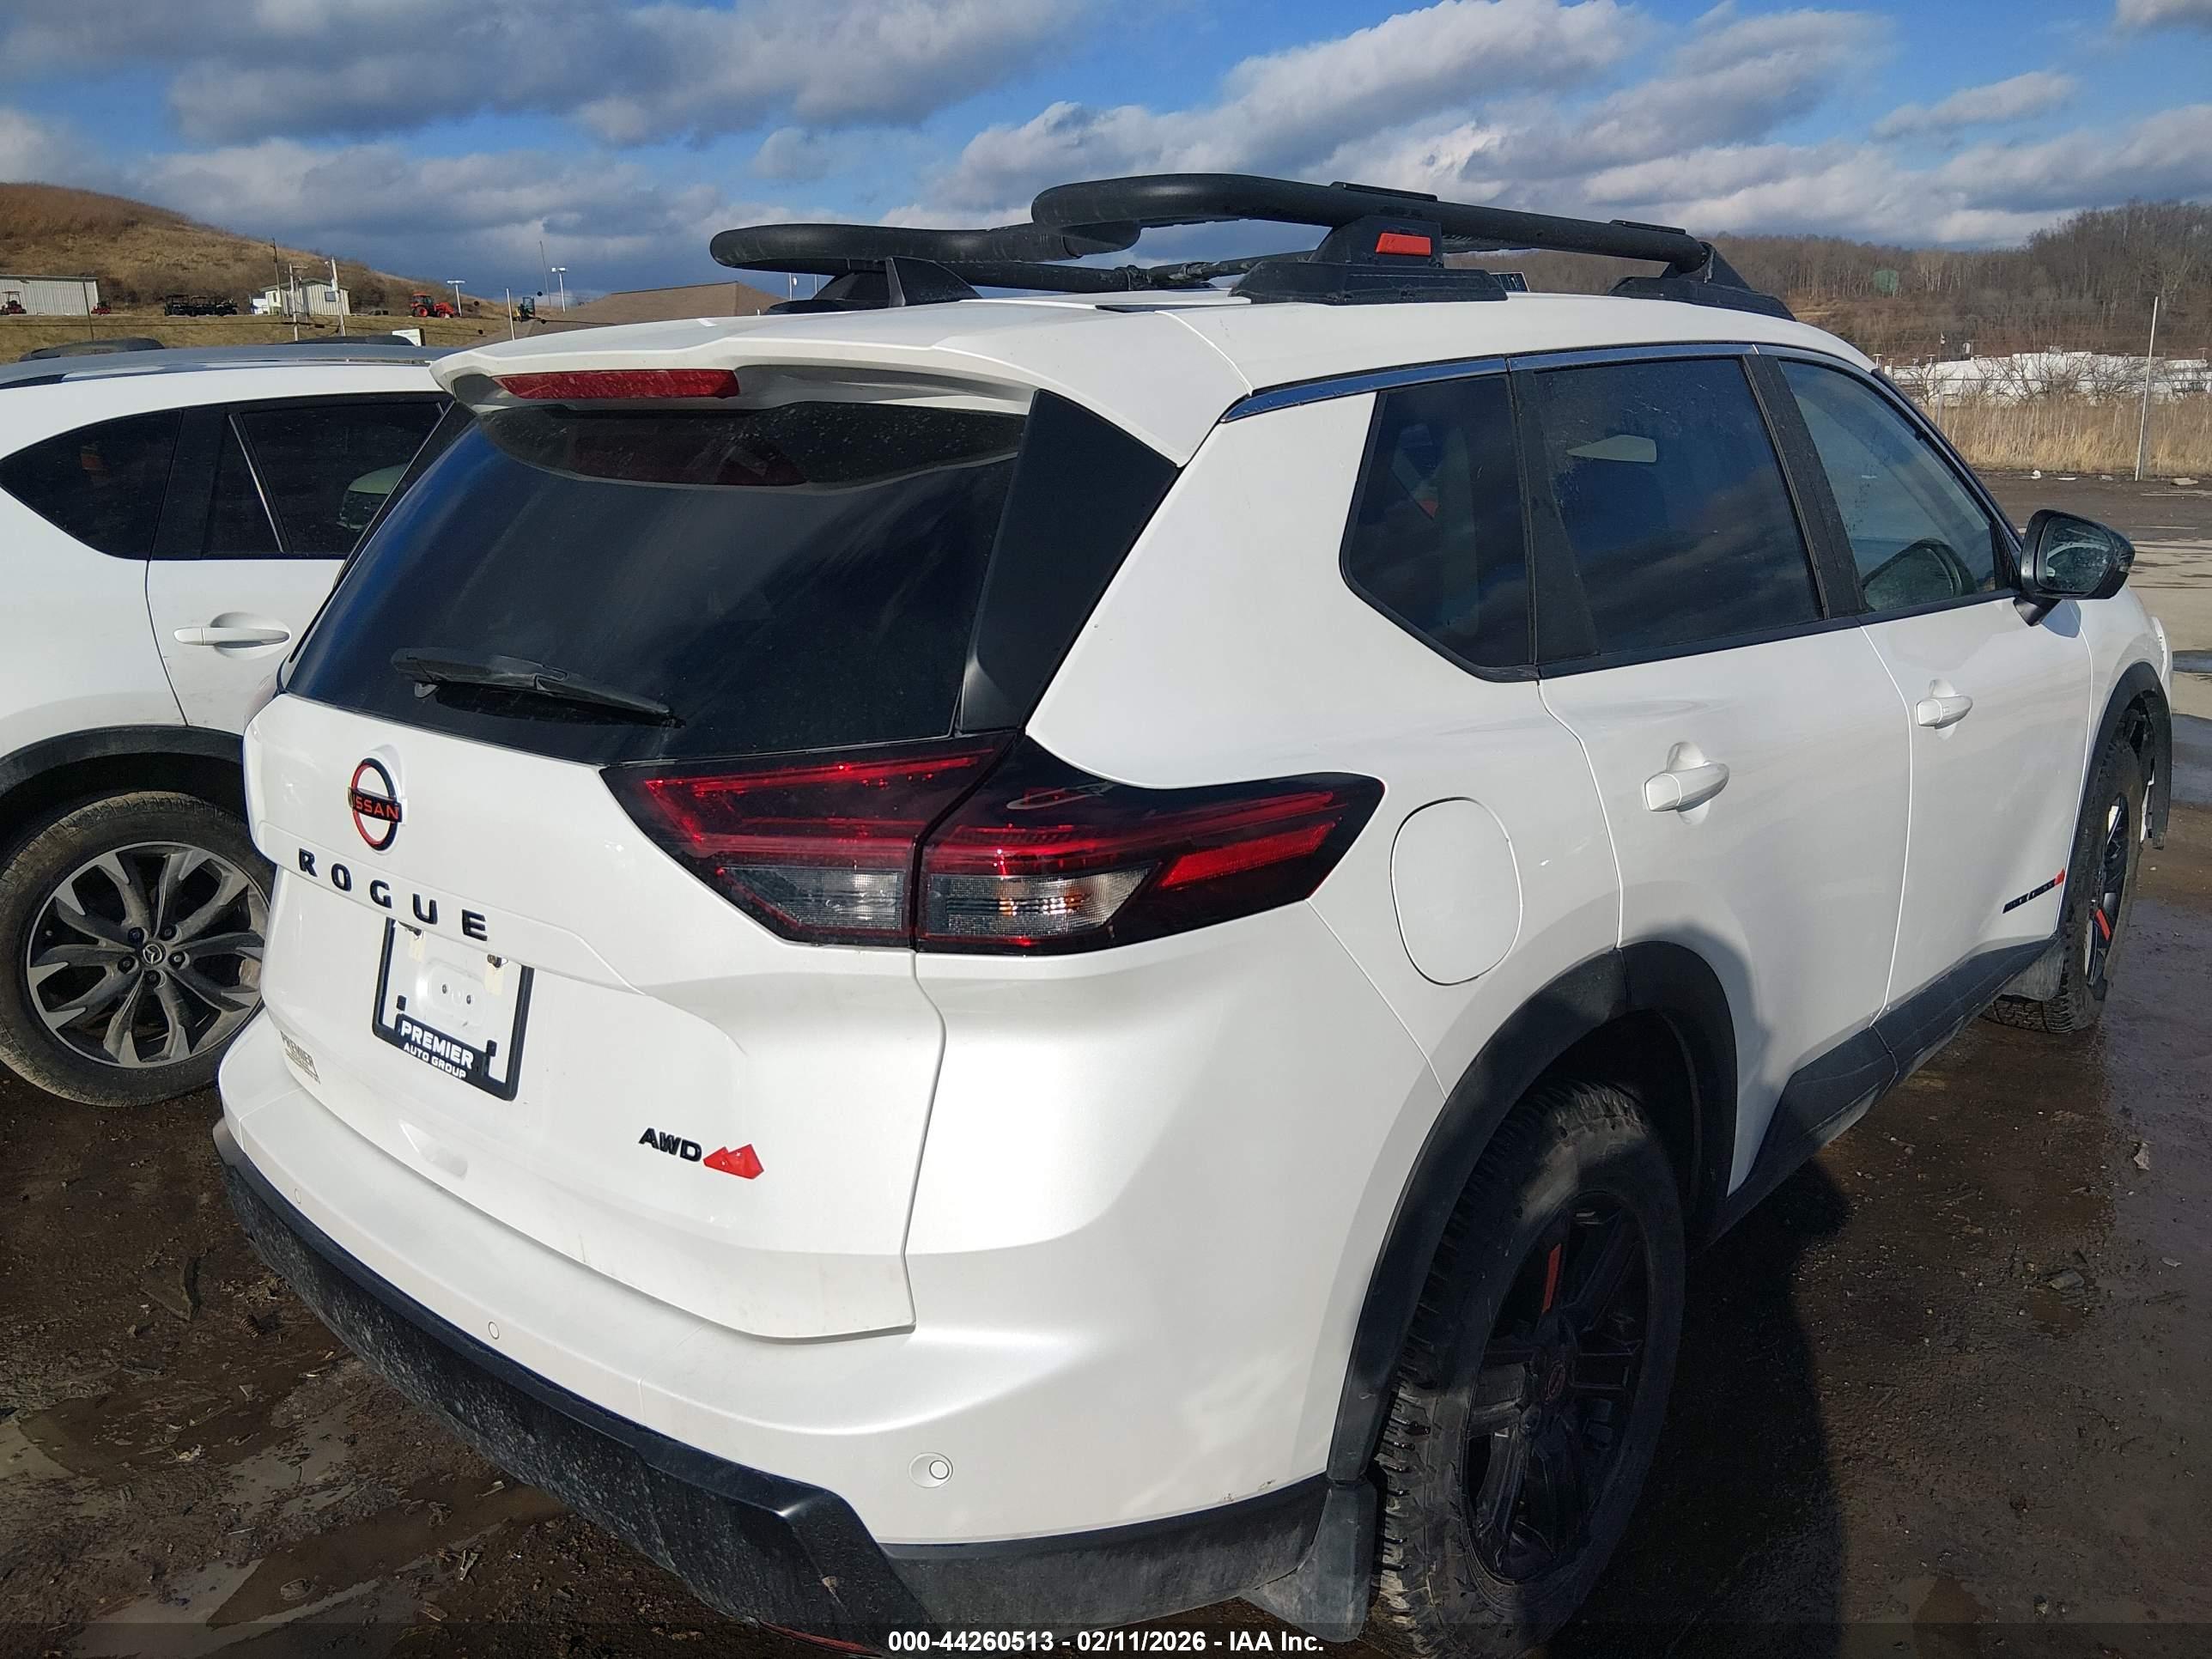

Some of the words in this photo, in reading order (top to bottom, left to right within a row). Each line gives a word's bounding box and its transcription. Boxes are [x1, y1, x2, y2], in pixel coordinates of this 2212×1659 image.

[298, 848, 489, 942] ROGUE
[400, 1020, 474, 1070] PREMIER
[404, 1042, 429, 1062] AUTO
[431, 1056, 467, 1079] GROUP
[639, 1127, 702, 1163] AWD
